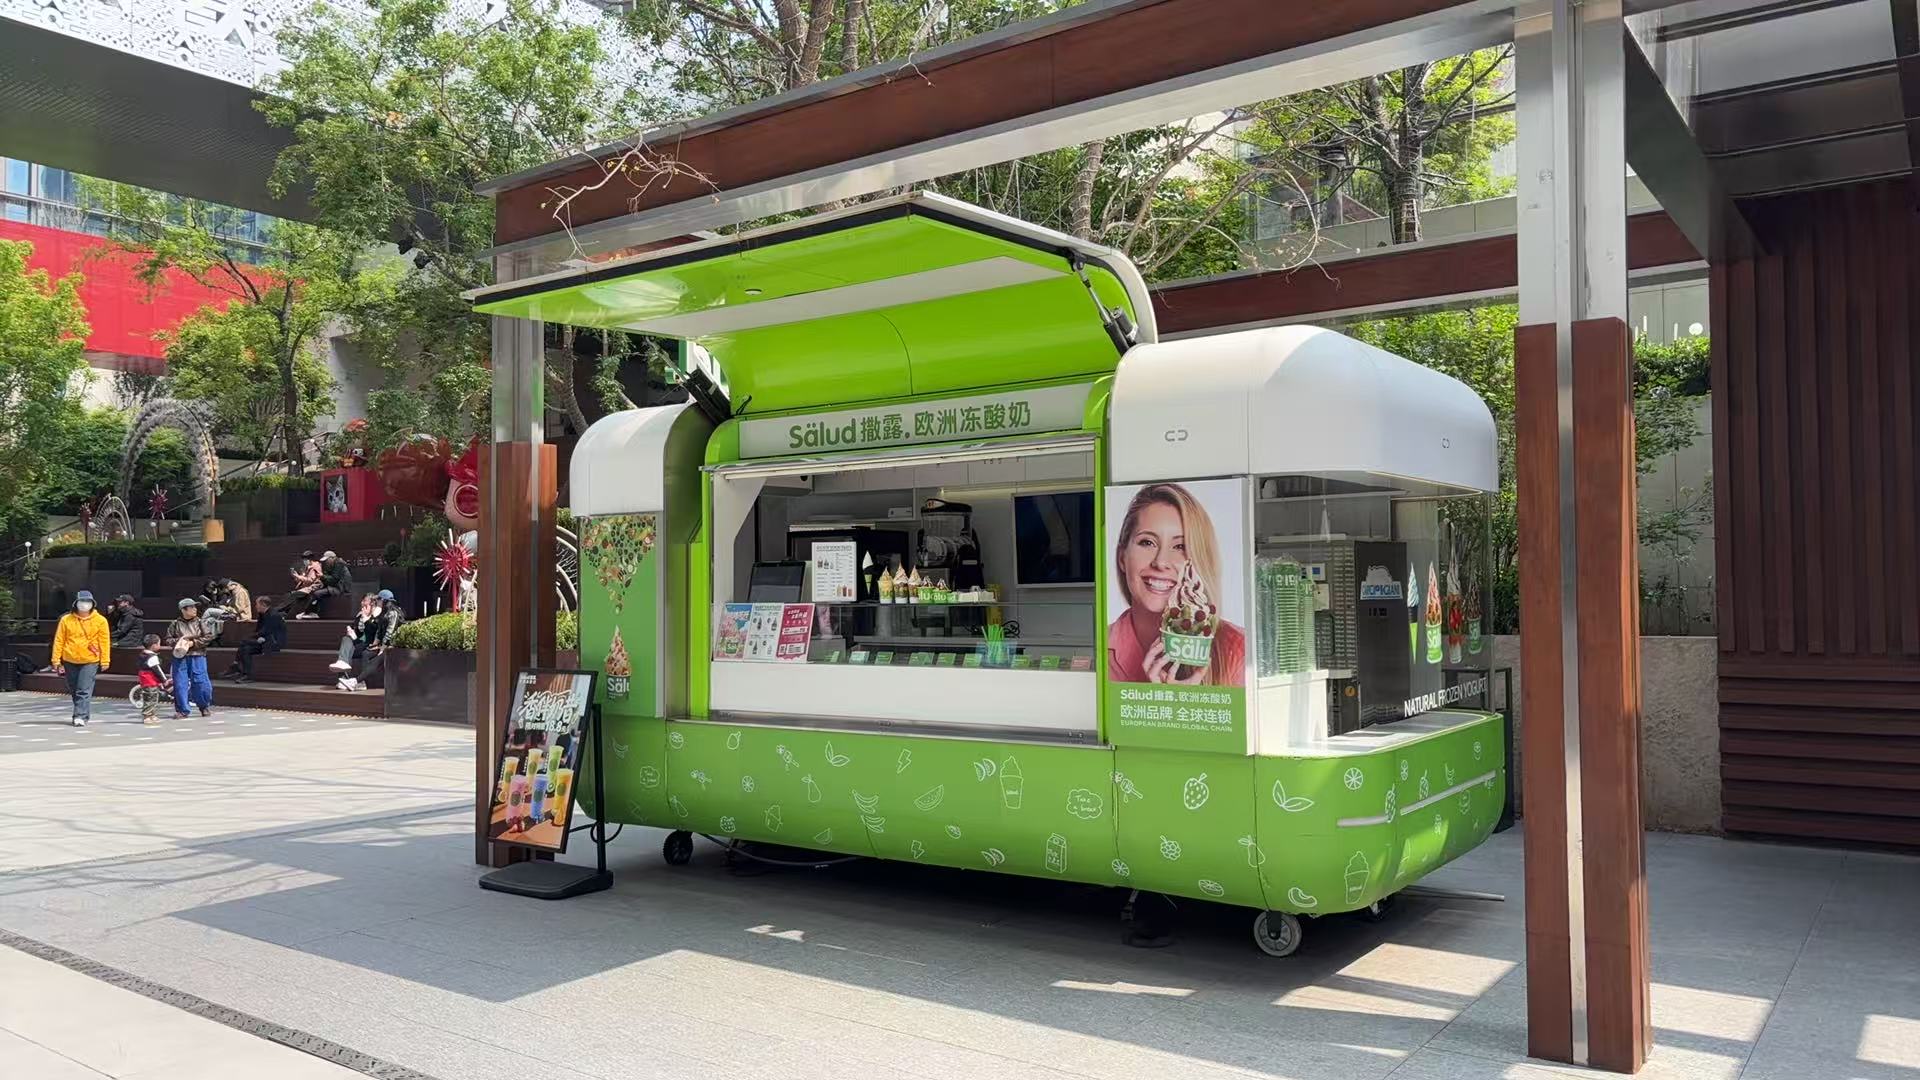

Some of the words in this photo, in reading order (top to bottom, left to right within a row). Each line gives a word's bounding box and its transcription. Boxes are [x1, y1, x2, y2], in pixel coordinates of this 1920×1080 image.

[789, 418, 856, 449] Sälud
[1120, 689, 1153, 701] Sälud
[1404, 691, 1438, 718] NATURAL
[1438, 684, 1463, 707] FROZEN
[1120, 704, 1173, 721] 欧洲品牌
[1176, 706, 1232, 724] 全球连锁
[1120, 719, 1157, 728] EUROPEAN
[1157, 721, 1180, 729] BRAND
[1182, 723, 1209, 731] GLOBAL
[1210, 725, 1233, 733] CHAIN
